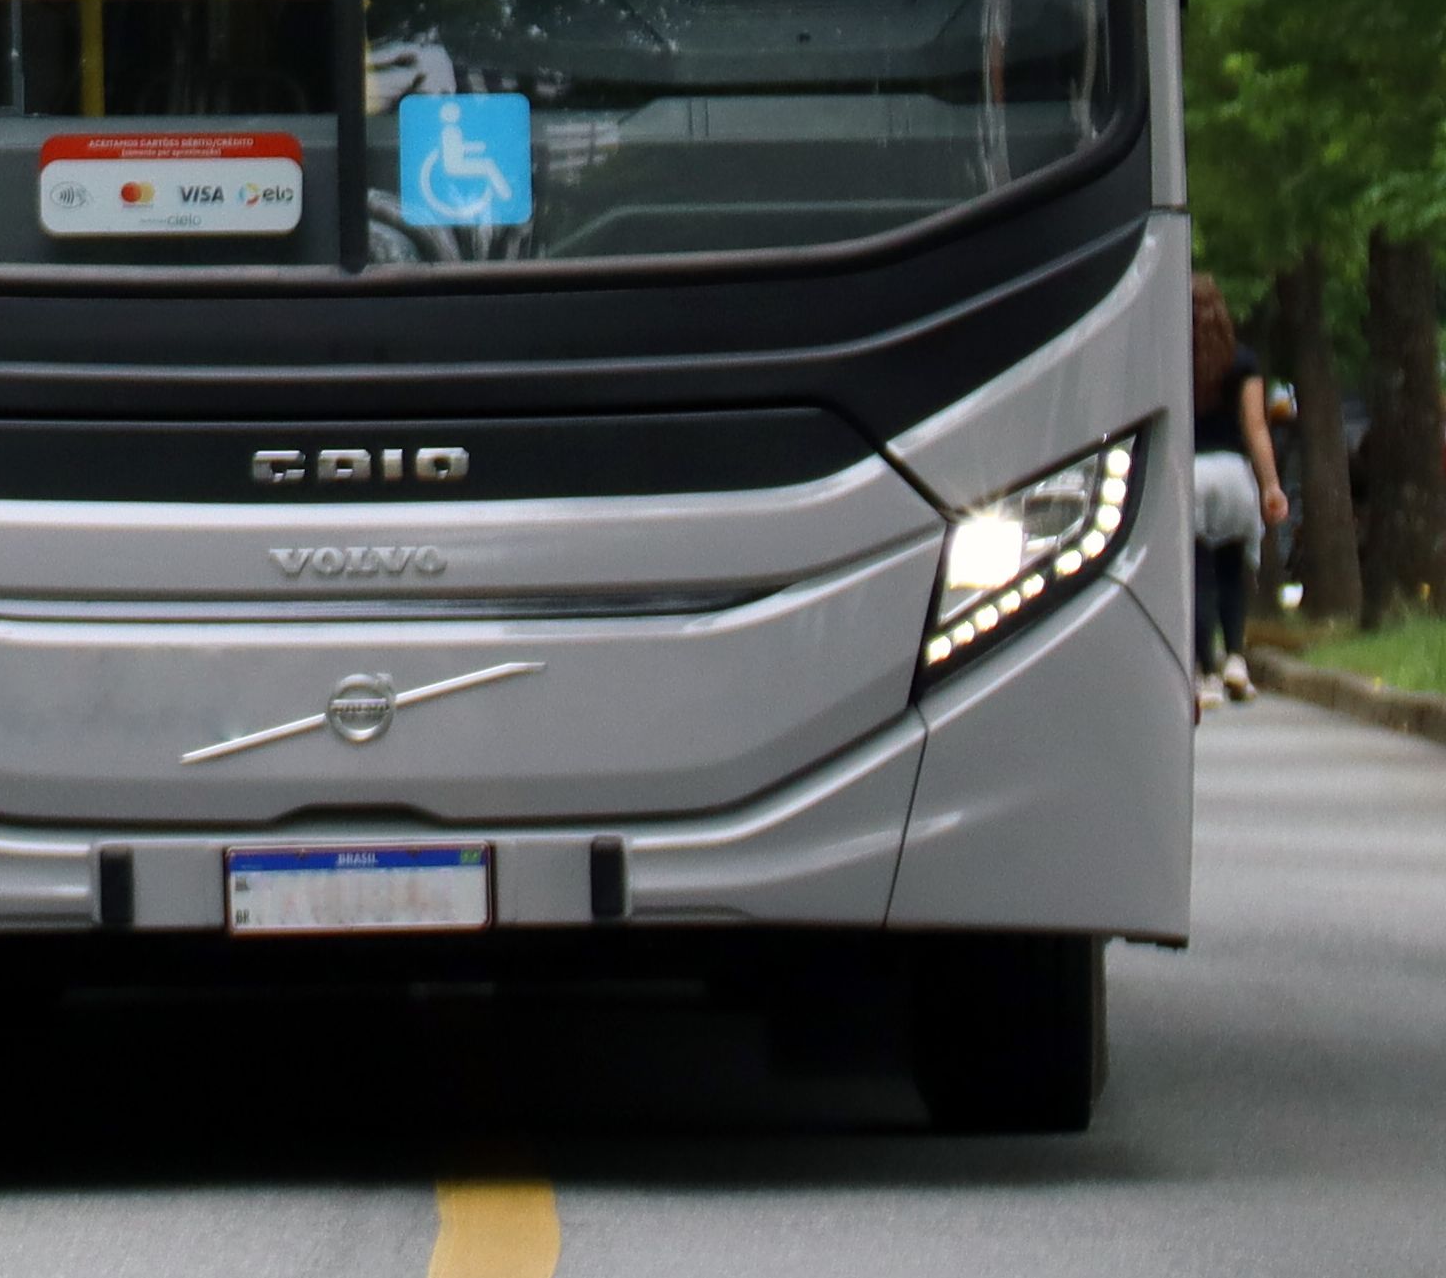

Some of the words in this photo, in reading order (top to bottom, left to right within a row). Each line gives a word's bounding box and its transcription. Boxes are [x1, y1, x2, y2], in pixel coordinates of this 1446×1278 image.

[89, 138, 138, 147] ACEITAMOS
[140, 137, 180, 147] CARTÕES
[181, 136, 254, 148] DÉBITO/CRÉDITO
[180, 186, 224, 203] VISA
[262, 186, 294, 202] elo
[167, 214, 202, 227] cielo
[252, 447, 470, 483] CAIO
[268, 545, 448, 577] VOLVO
[337, 852, 378, 865] BRASIL
